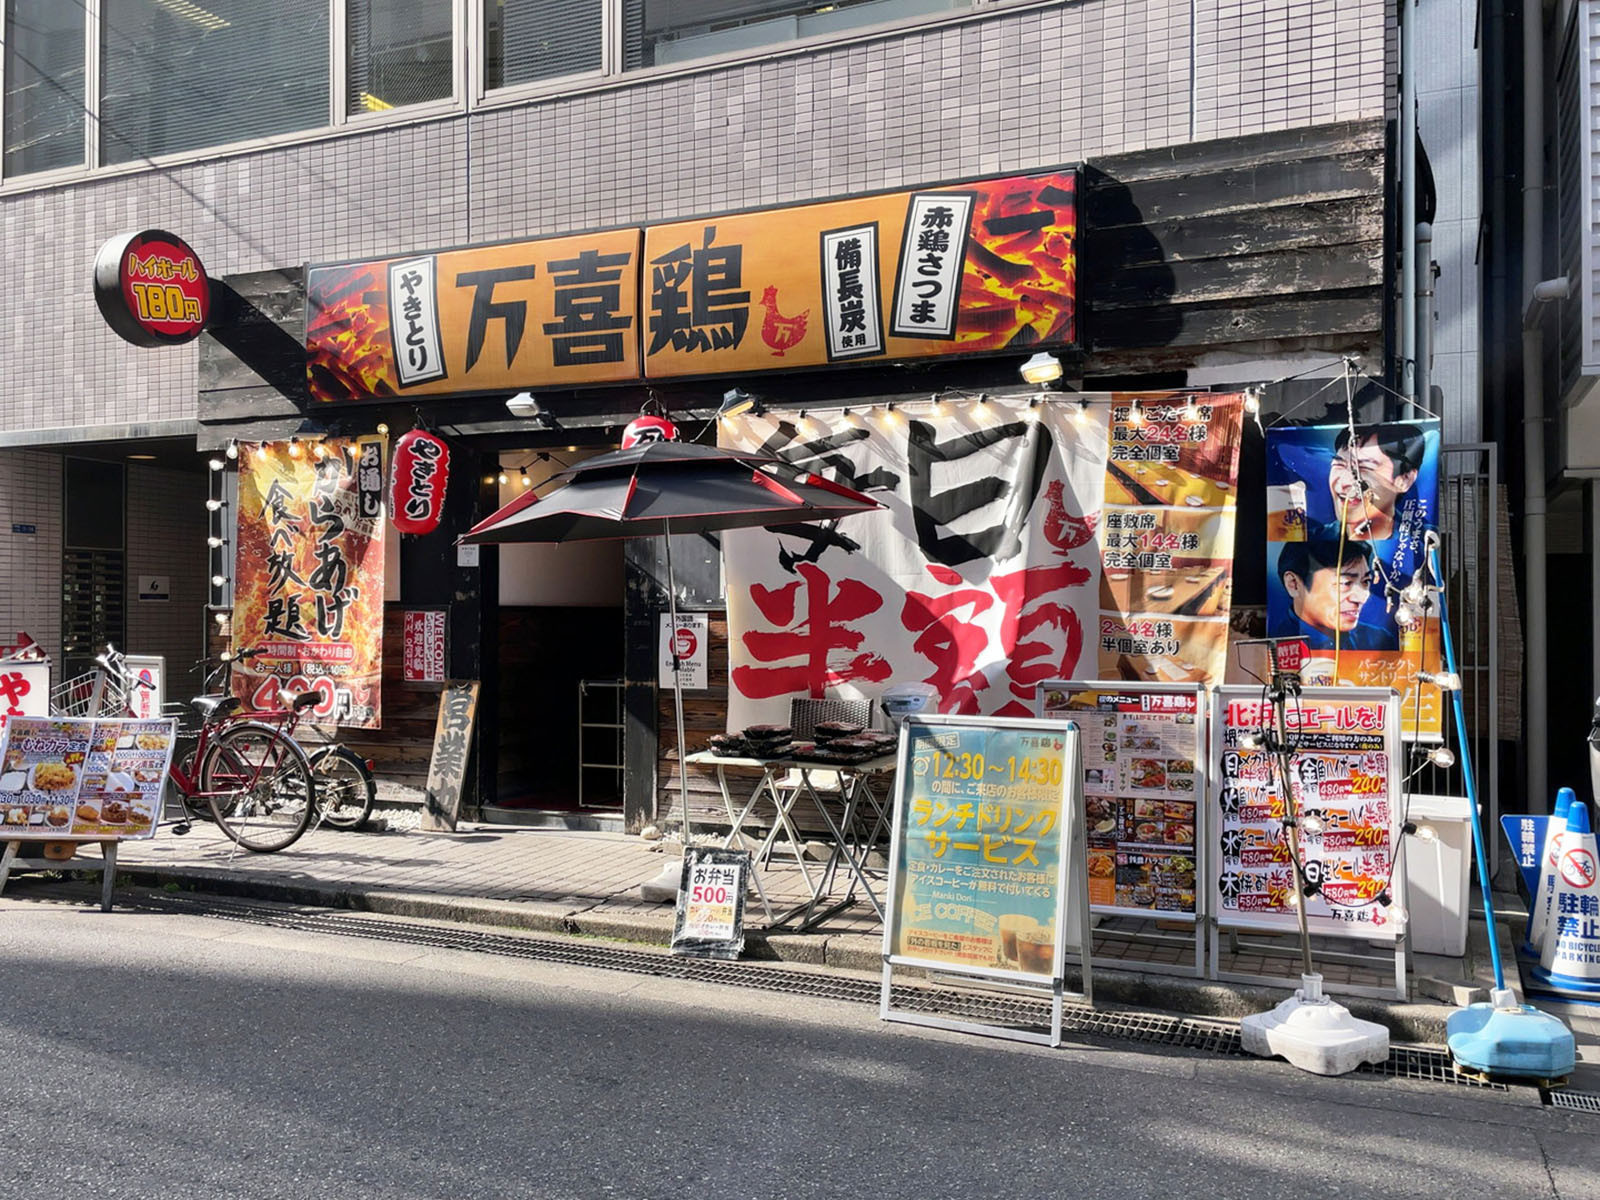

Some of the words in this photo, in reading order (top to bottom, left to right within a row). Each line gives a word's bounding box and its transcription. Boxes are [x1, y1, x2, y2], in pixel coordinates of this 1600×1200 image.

[130, 254, 198, 283] ハイボール
[910, 206, 954, 325] 赤鶏さつま
[835, 238, 866, 333] 備長炭
[133, 283, 201, 322] 180円
[456, 226, 750, 374] 万喜鶏
[400, 269, 429, 372] やきとり
[841, 333, 867, 349] 使用
[1113, 425, 1208, 442] 最大24名様
[1111, 444, 1179, 461] 完全個室
[405, 437, 442, 520] やきとり
[1106, 513, 1156, 529] 座敷席
[1107, 533, 1198, 550] 最大14名様
[258, 478, 311, 641] 食べ放題
[1104, 552, 1171, 568] 完全個室
[435, 612, 445, 680] WELCOME
[1102, 638, 1180, 655] 半個室あり
[1357, 658, 1415, 671] パーフェクト
[1225, 753, 1238, 776] 月
[1301, 759, 1318, 784] 金
[913, 799, 1058, 838] ランチドリンク
[926, 830, 1040, 867] サービス
[1223, 831, 1237, 854] 水
[1520, 818, 1536, 867] 駐輪禁止
[693, 868, 735, 886] お弁当
[1221, 872, 1239, 897] 木
[691, 886, 734, 904] 500円
[1558, 892, 1600, 917] 駐輪
[1557, 915, 1600, 940] 禁止
